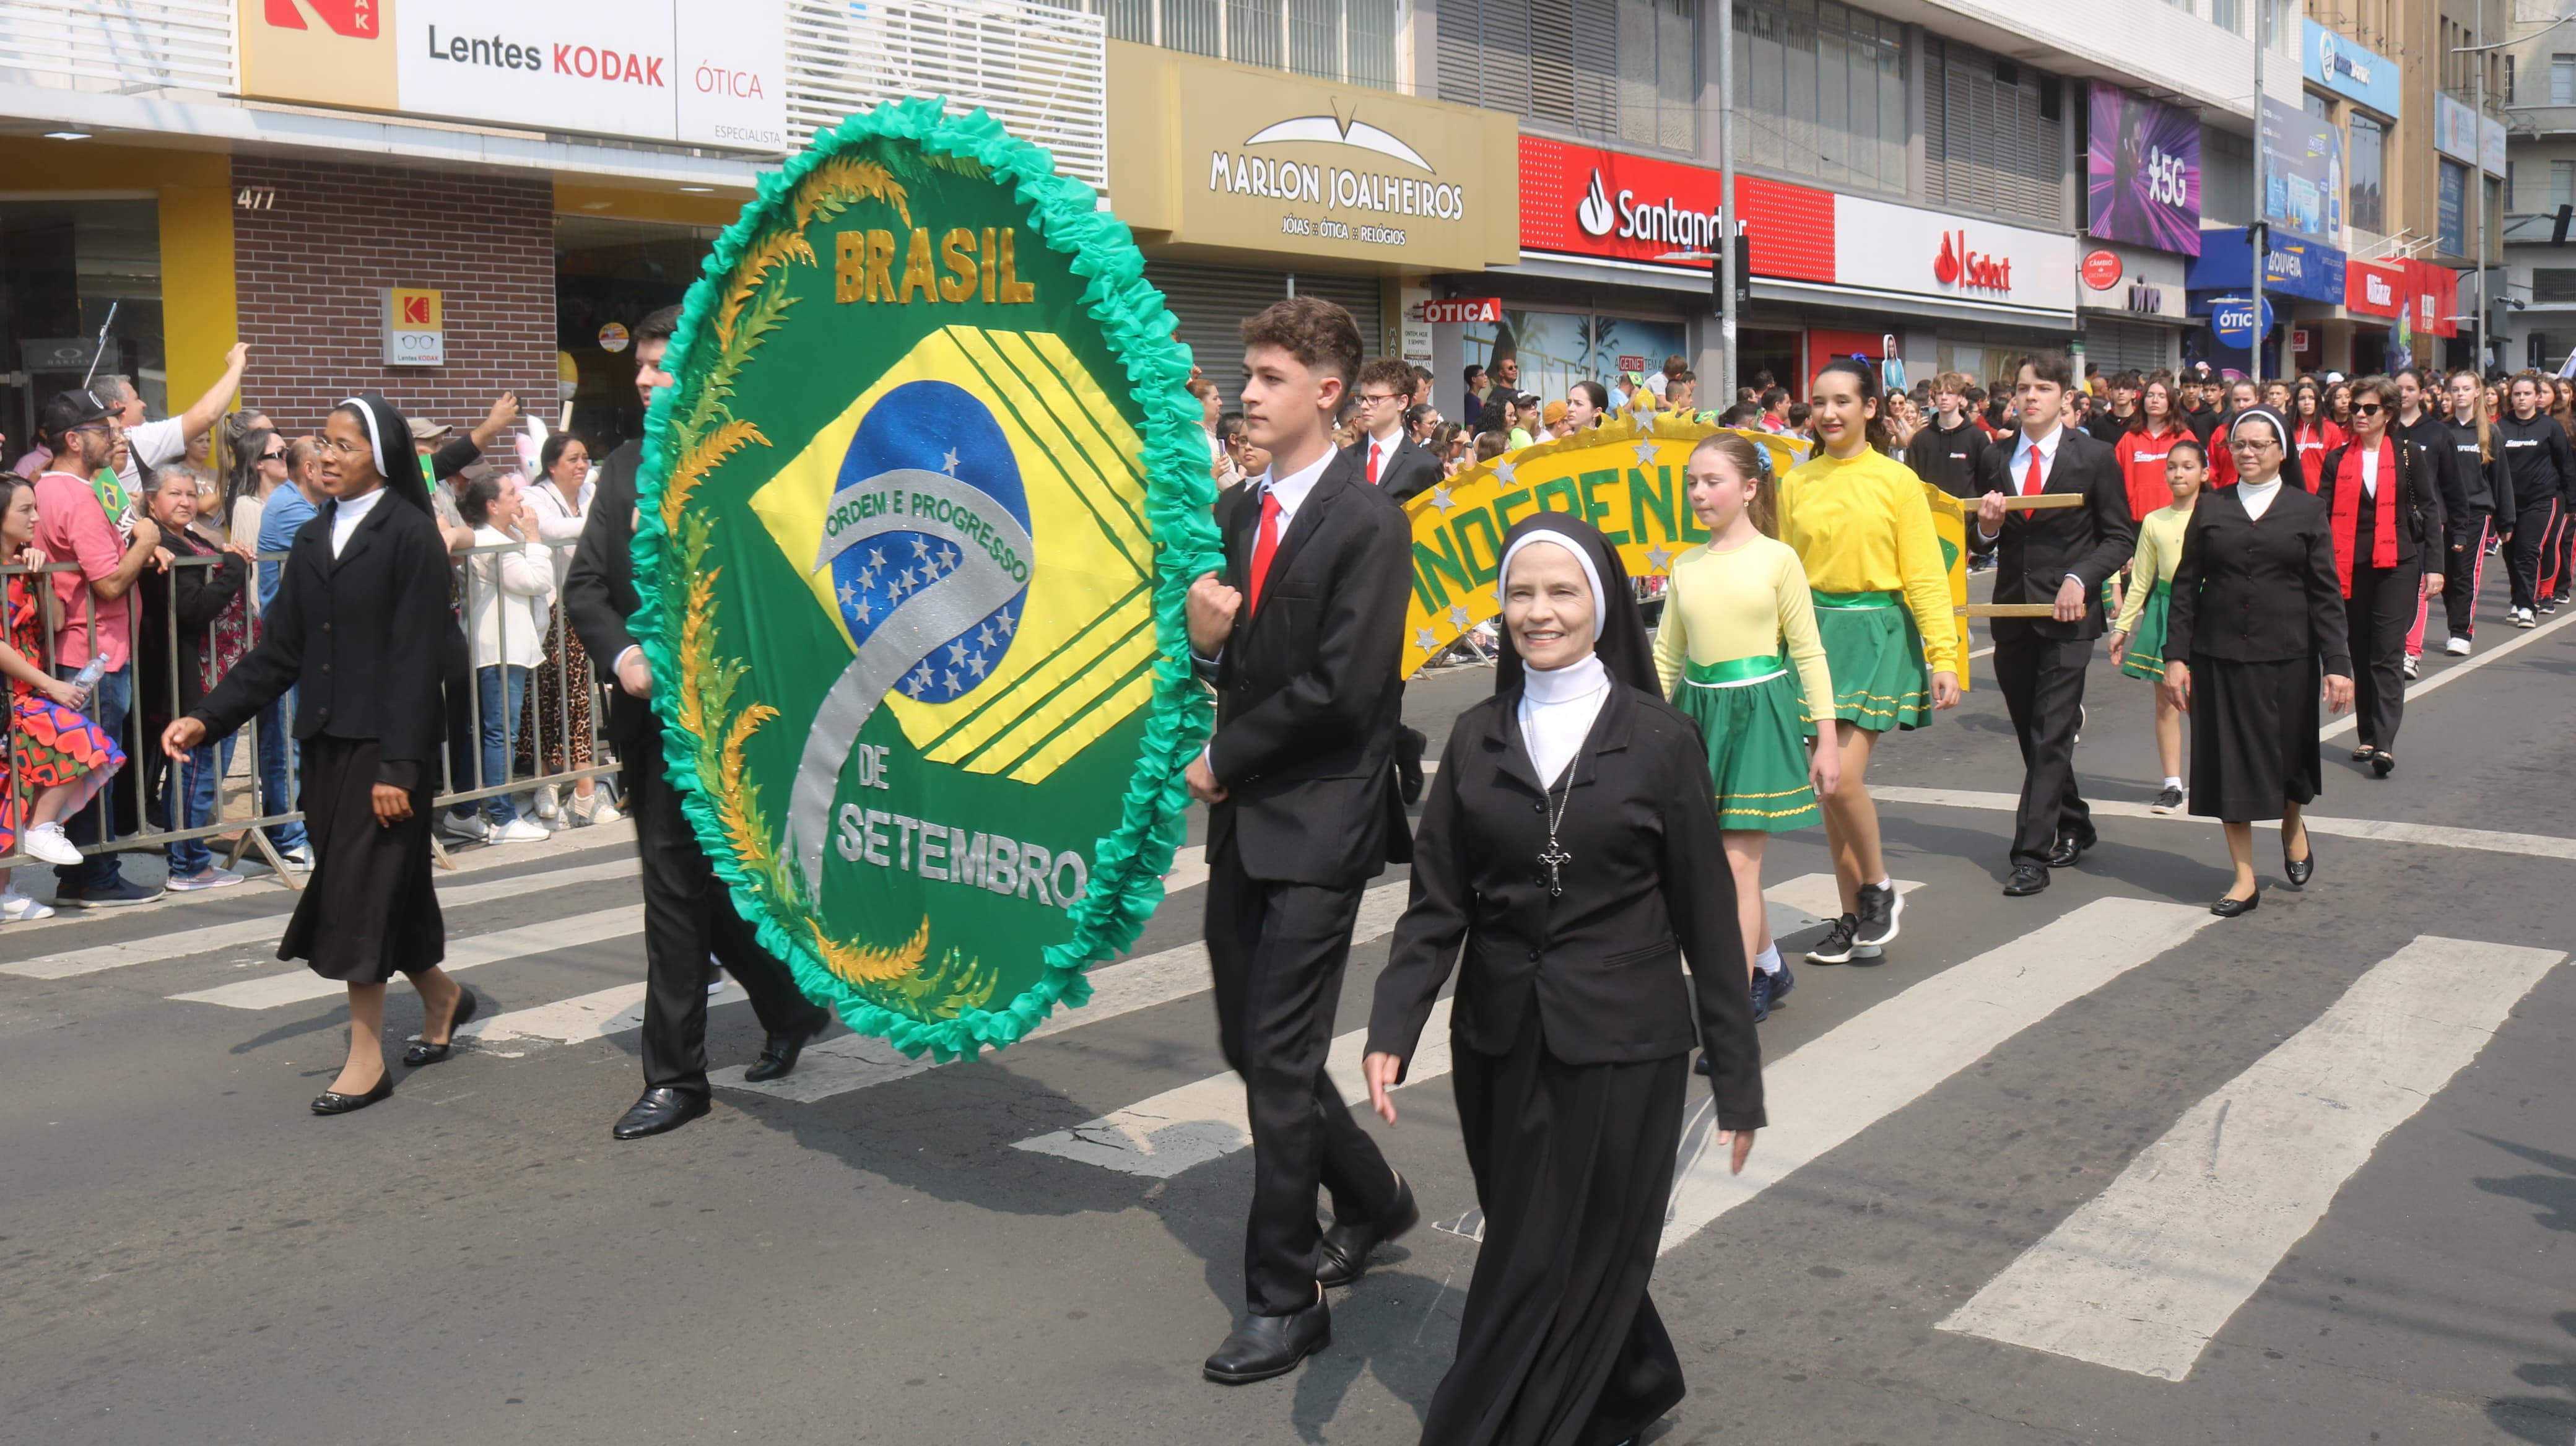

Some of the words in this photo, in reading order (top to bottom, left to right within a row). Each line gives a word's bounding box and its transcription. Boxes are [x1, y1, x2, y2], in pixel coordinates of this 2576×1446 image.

[429, 24, 541, 71] Lentes
[554, 43, 664, 87] KODAK
[696, 59, 764, 100] ÓTICA
[715, 125, 781, 144] ESPECIALISTA
[237, 186, 276, 209] 477
[1209, 150, 1320, 203] MARLON
[1328, 167, 1463, 221] JOALHEIROS
[2161, 154, 2187, 207] 5G
[1281, 213, 1310, 235] JÓIAS
[1320, 217, 1349, 239] ÓTICA
[1361, 224, 1406, 246] RELÓGIOS
[1615, 189, 1747, 248] Santandr
[835, 227, 1035, 304] BRASIL
[1966, 251, 2011, 291] Select
[2089, 258, 2113, 267] CÂMBIO
[2268, 250, 2302, 278] GOUVEIA
[1425, 300, 1495, 322] ÓTICA
[2219, 310, 2263, 327] ÓTIC
[1620, 357, 1643, 370] GETNET
[1644, 359, 1657, 370] TEM
[826, 491, 887, 536] ORDEM
[894, 490, 903, 513] E
[912, 492, 1028, 583] PROGRESSO
[859, 744, 890, 790] DE
[837, 803, 1088, 910] SETEMBRO
